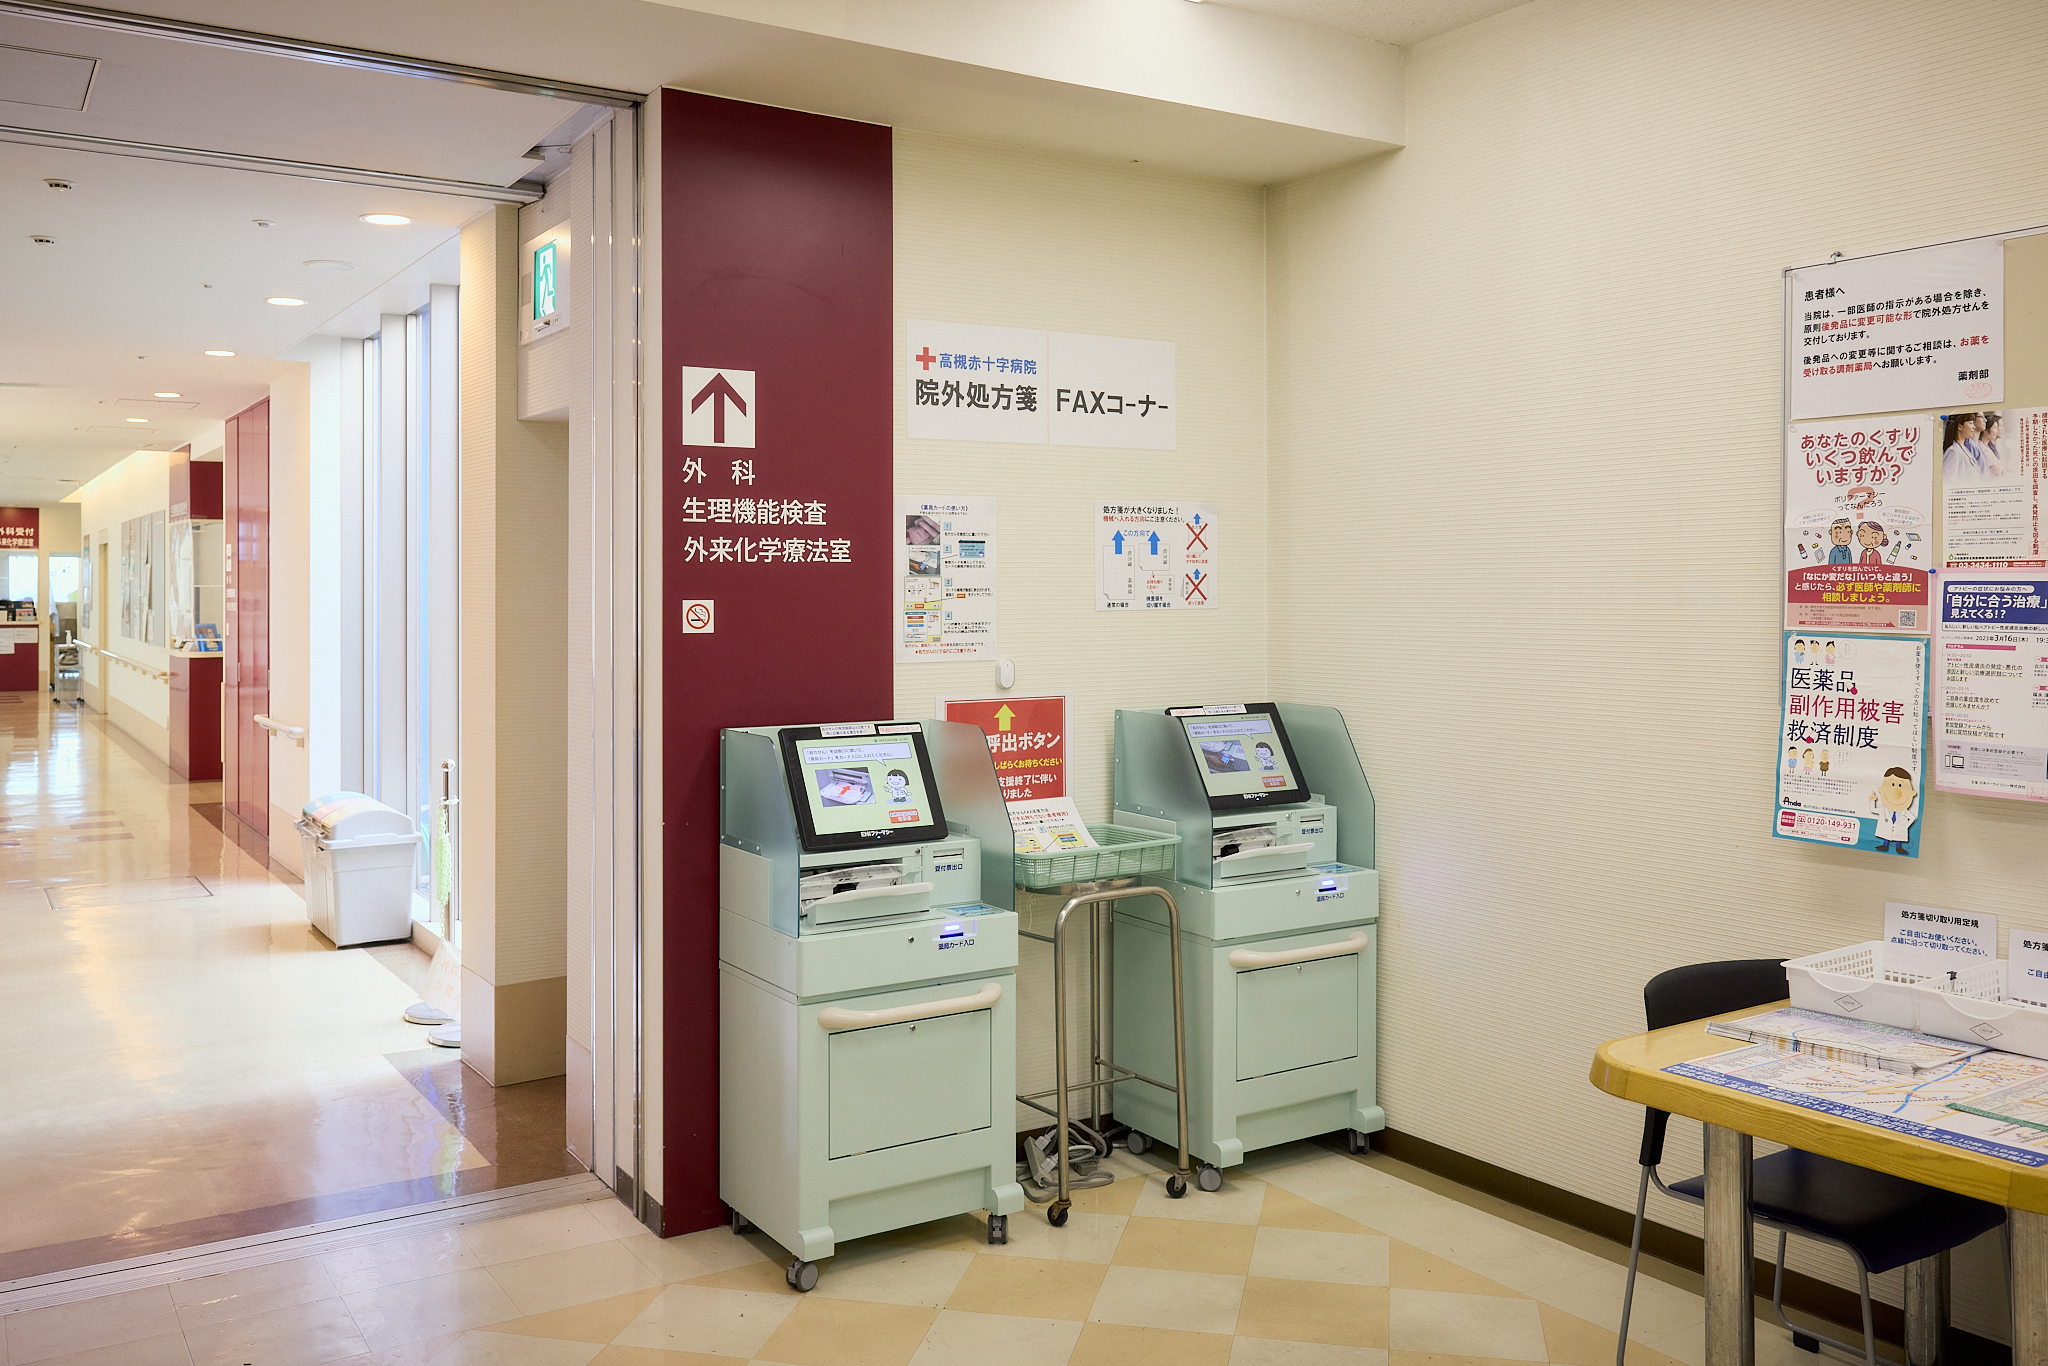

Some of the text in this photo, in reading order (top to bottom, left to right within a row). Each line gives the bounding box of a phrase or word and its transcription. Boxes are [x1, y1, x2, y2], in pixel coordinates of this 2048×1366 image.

[1804, 287, 1845, 301] 患者様へ
[1804, 287, 1987, 321] 当院は、一部医師の指示がある場合を除き、
[1803, 300, 1990, 334] 原則後発品に変更可能な形で院外処方せんを
[1803, 330, 1870, 346] 交付しております。
[1803, 335, 1989, 365] 後発品への変更等に関するご相談は、お薬を
[939, 352, 1037, 375] 高槻赤十字病院
[1803, 355, 1937, 378] 受け取る調剤薬局へお願いします。
[1957, 369, 1989, 382] 薬剤部
[915, 378, 1037, 412] 院外処方箋
[1056, 388, 1169, 418] FAXコーナー
[1800, 427, 1918, 450] あなたのくすり
[1806, 445, 1914, 467] いくつ飲んで
[1834, 491, 1885, 503] ポリファーマシー
[1838, 500, 1883, 511] ってなんだろう
[682, 496, 827, 526] 生理機能検査
[684, 536, 852, 564] 外来化学療法室
[1794, 582, 1922, 593] と感じたら、必ず医師や薬剤師に
[1802, 572, 1913, 582] 「なにか変だな」「いつもと違う」
[1822, 592, 1890, 603] 相談しましょう。
[1790, 667, 1856, 693] 医薬品
[1789, 694, 1905, 724] 副作用被害
[1786, 719, 1879, 749] 救済制度
[994, 757, 1063, 770] しばらくお待ちください
[1807, 817, 1856, 829] 0120-149-931
[934, 863, 963, 872] 受付票出口
[1901, 910, 1979, 929] 処方箋切り取り用定規
[1890, 936, 1989, 957] 点線に沿って切り取ってください。
[1899, 928, 1979, 947] ご自由にお使いください。
